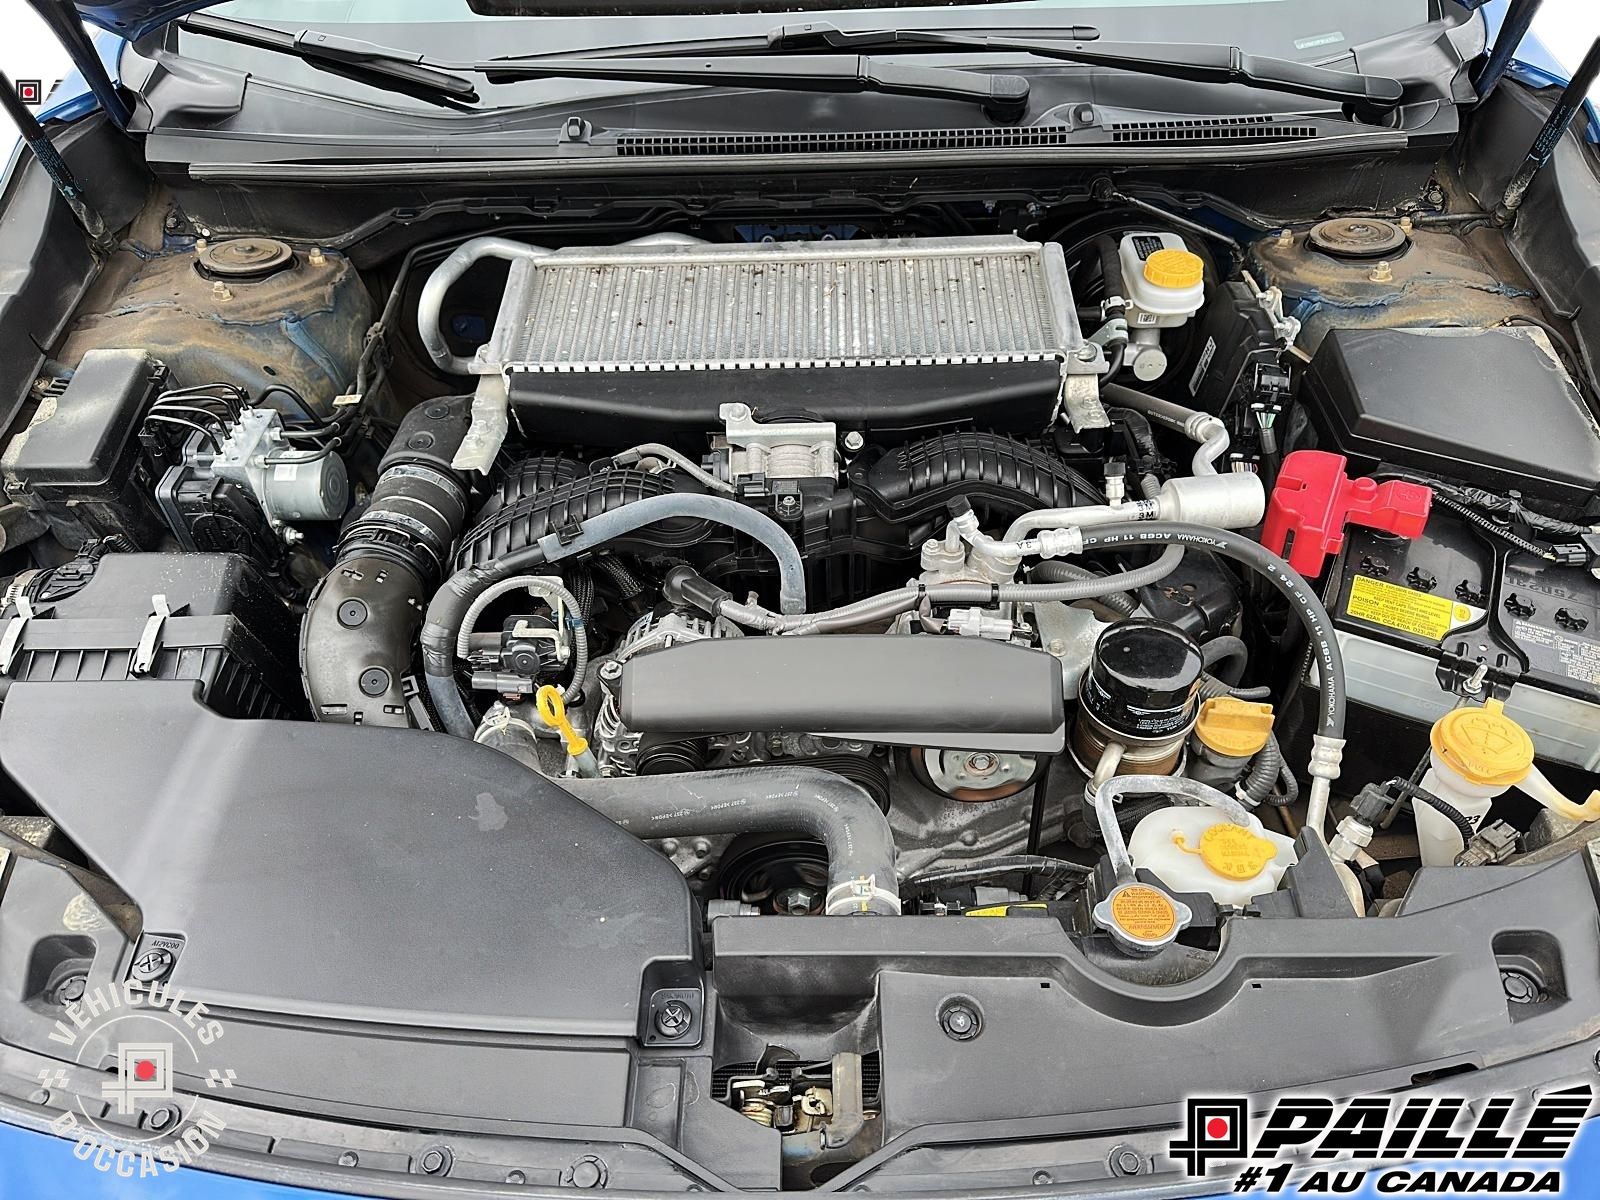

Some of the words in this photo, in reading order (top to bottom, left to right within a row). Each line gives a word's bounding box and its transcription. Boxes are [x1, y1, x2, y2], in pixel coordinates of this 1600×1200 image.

[1176, 533, 1217, 545] YOKOHAMA
[1356, 576, 1384, 587] DANGER
[1294, 591, 1307, 605] CF
[1353, 595, 1380, 606] POISON
[1306, 609, 1318, 623] HP
[1383, 618, 1396, 626] CCA
[1314, 625, 1324, 636] 11
[1327, 676, 1335, 716] YOKOHAMA
